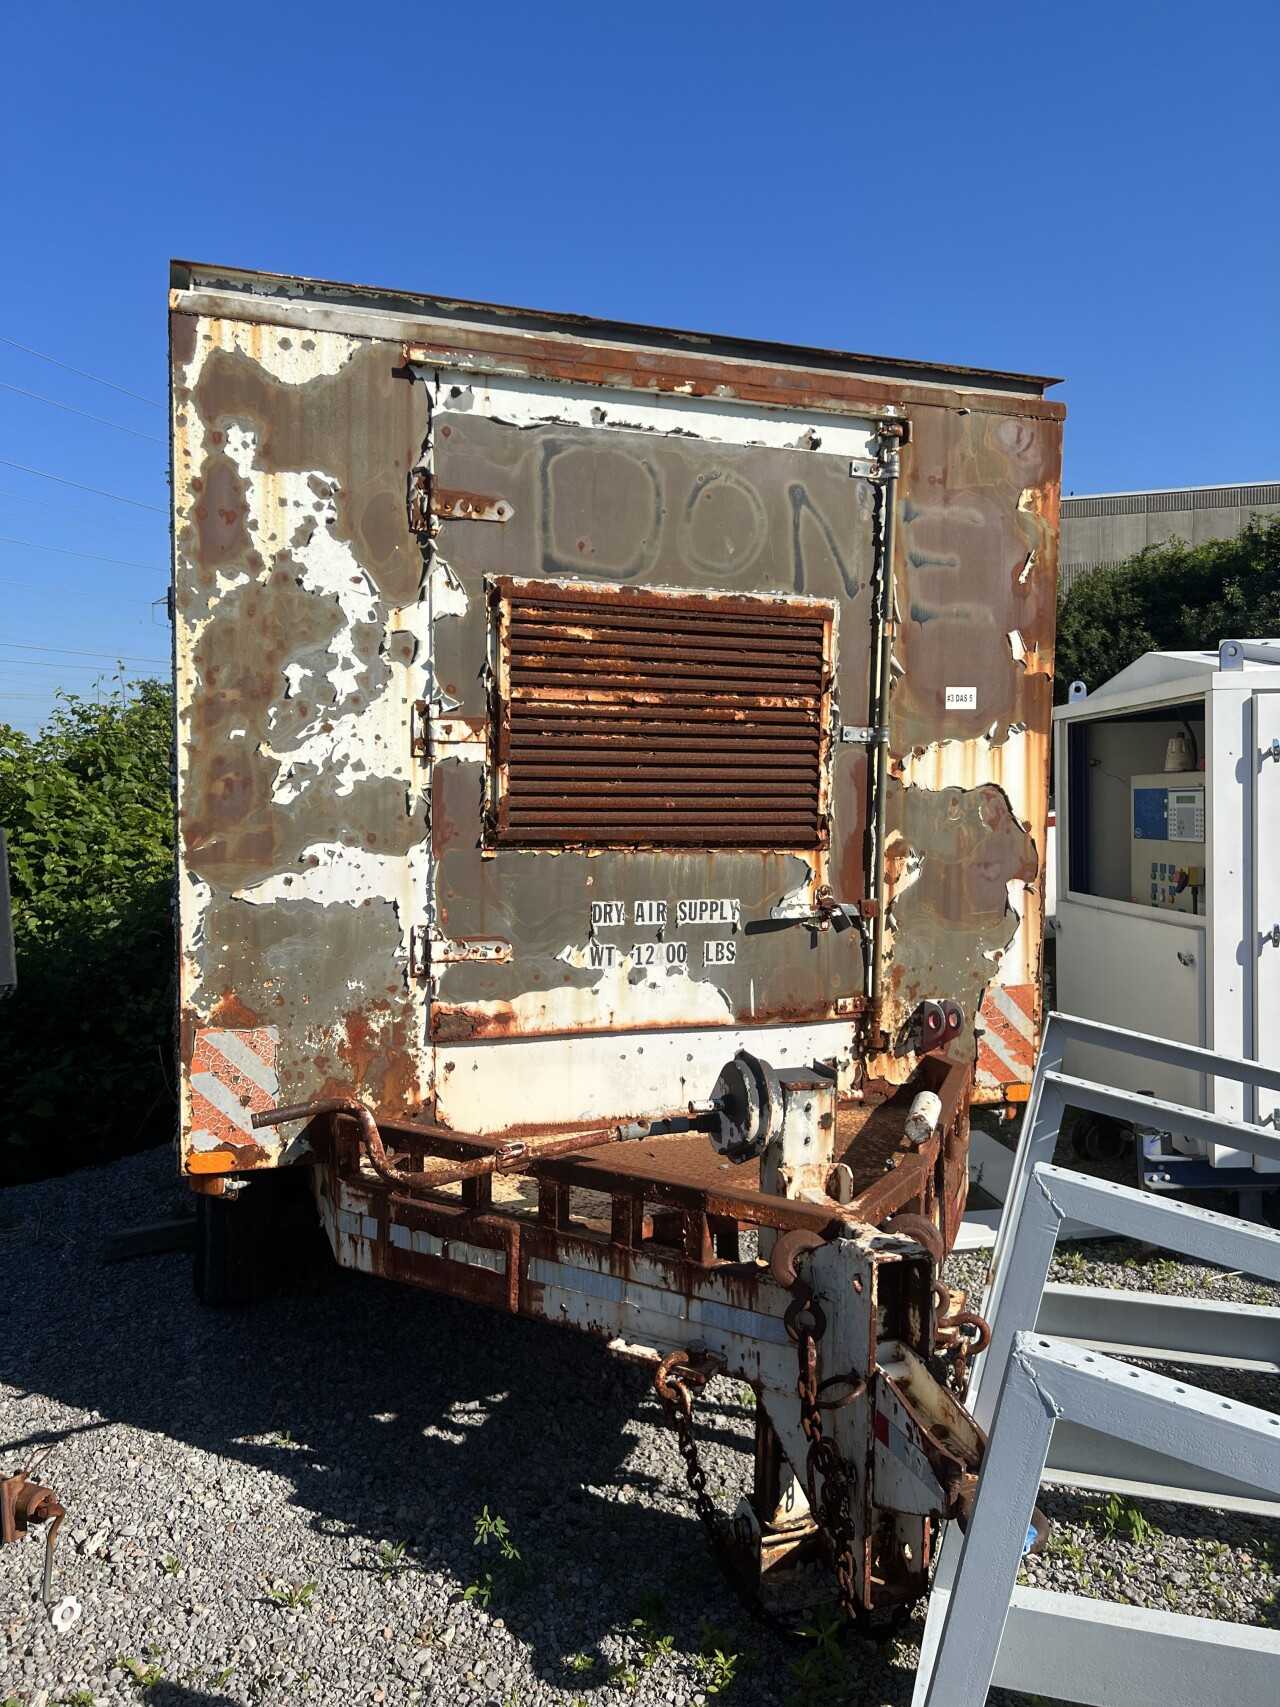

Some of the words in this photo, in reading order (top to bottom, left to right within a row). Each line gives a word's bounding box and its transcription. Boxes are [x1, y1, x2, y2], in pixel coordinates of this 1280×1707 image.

[592, 902, 624, 924] DRY
[635, 902, 667, 922] AIR
[679, 900, 740, 922] SUPPLY
[590, 946, 615, 967] WT
[705, 941, 736, 962] LBS
